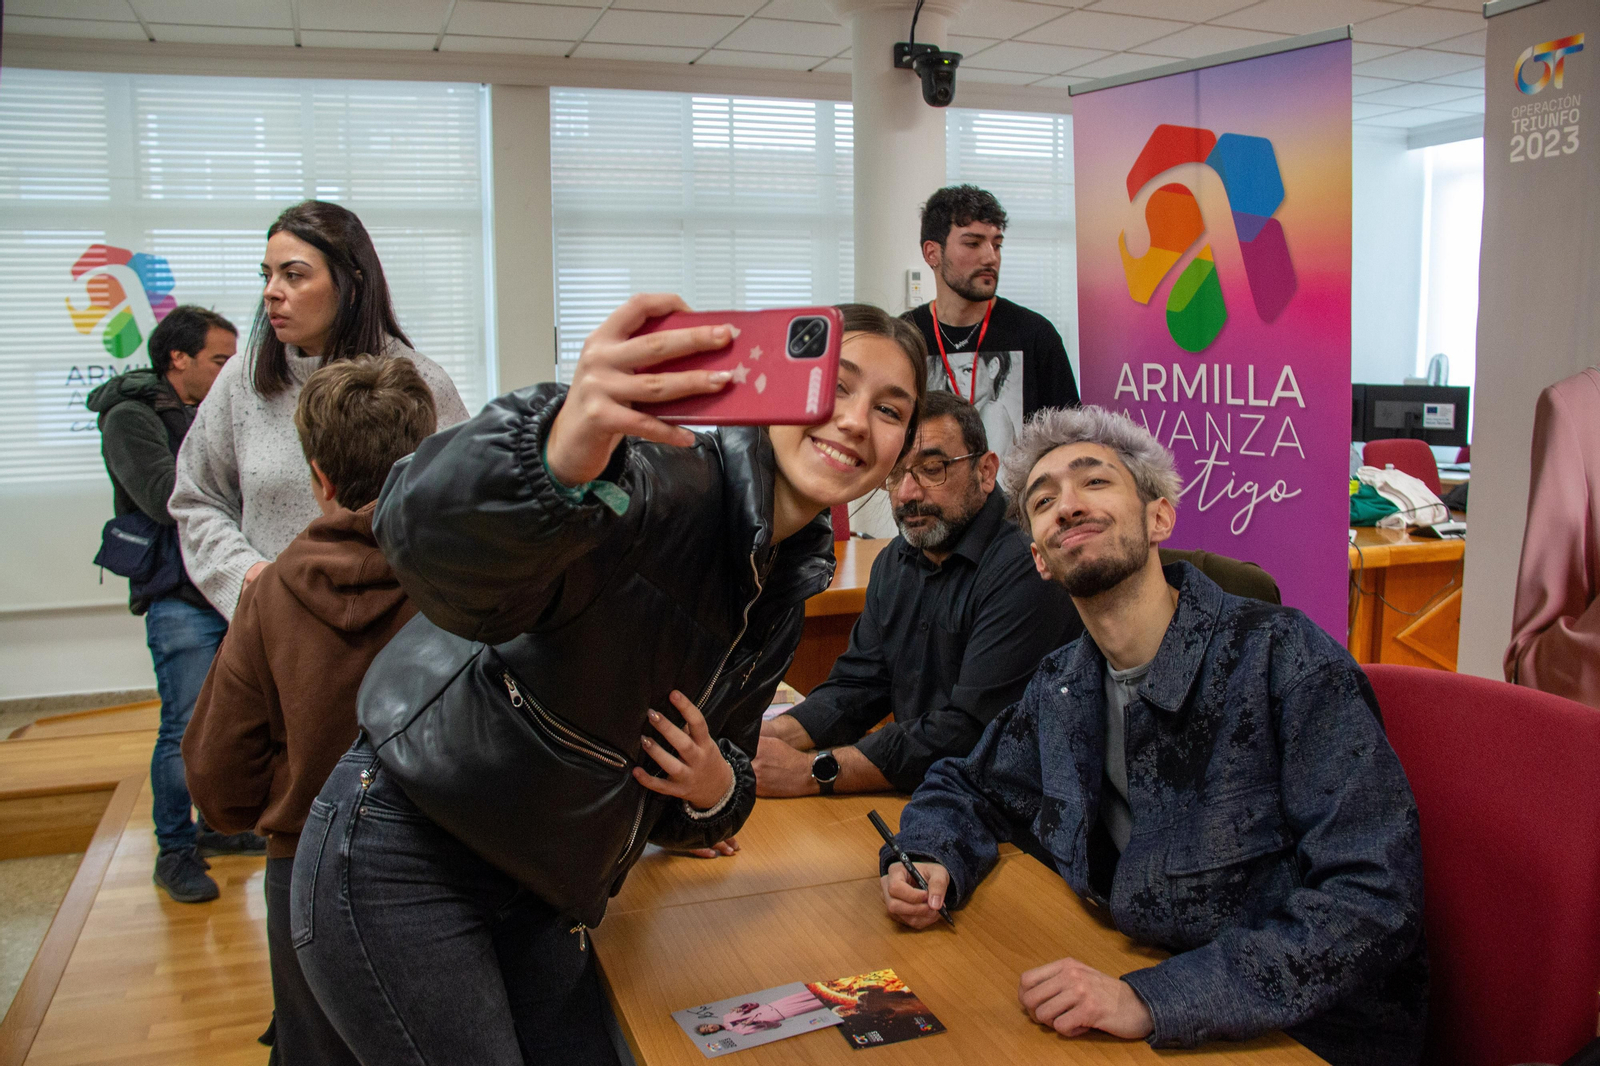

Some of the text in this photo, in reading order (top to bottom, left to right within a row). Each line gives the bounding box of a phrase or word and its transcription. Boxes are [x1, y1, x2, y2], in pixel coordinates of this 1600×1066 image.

[1511, 93, 1581, 119] OPERACIÓN
[1511, 107, 1580, 134] TRIUNFO
[1509, 124, 1580, 163] 2023
[1113, 362, 1306, 408] ARMILLA
[1122, 408, 1306, 459] VANZA
